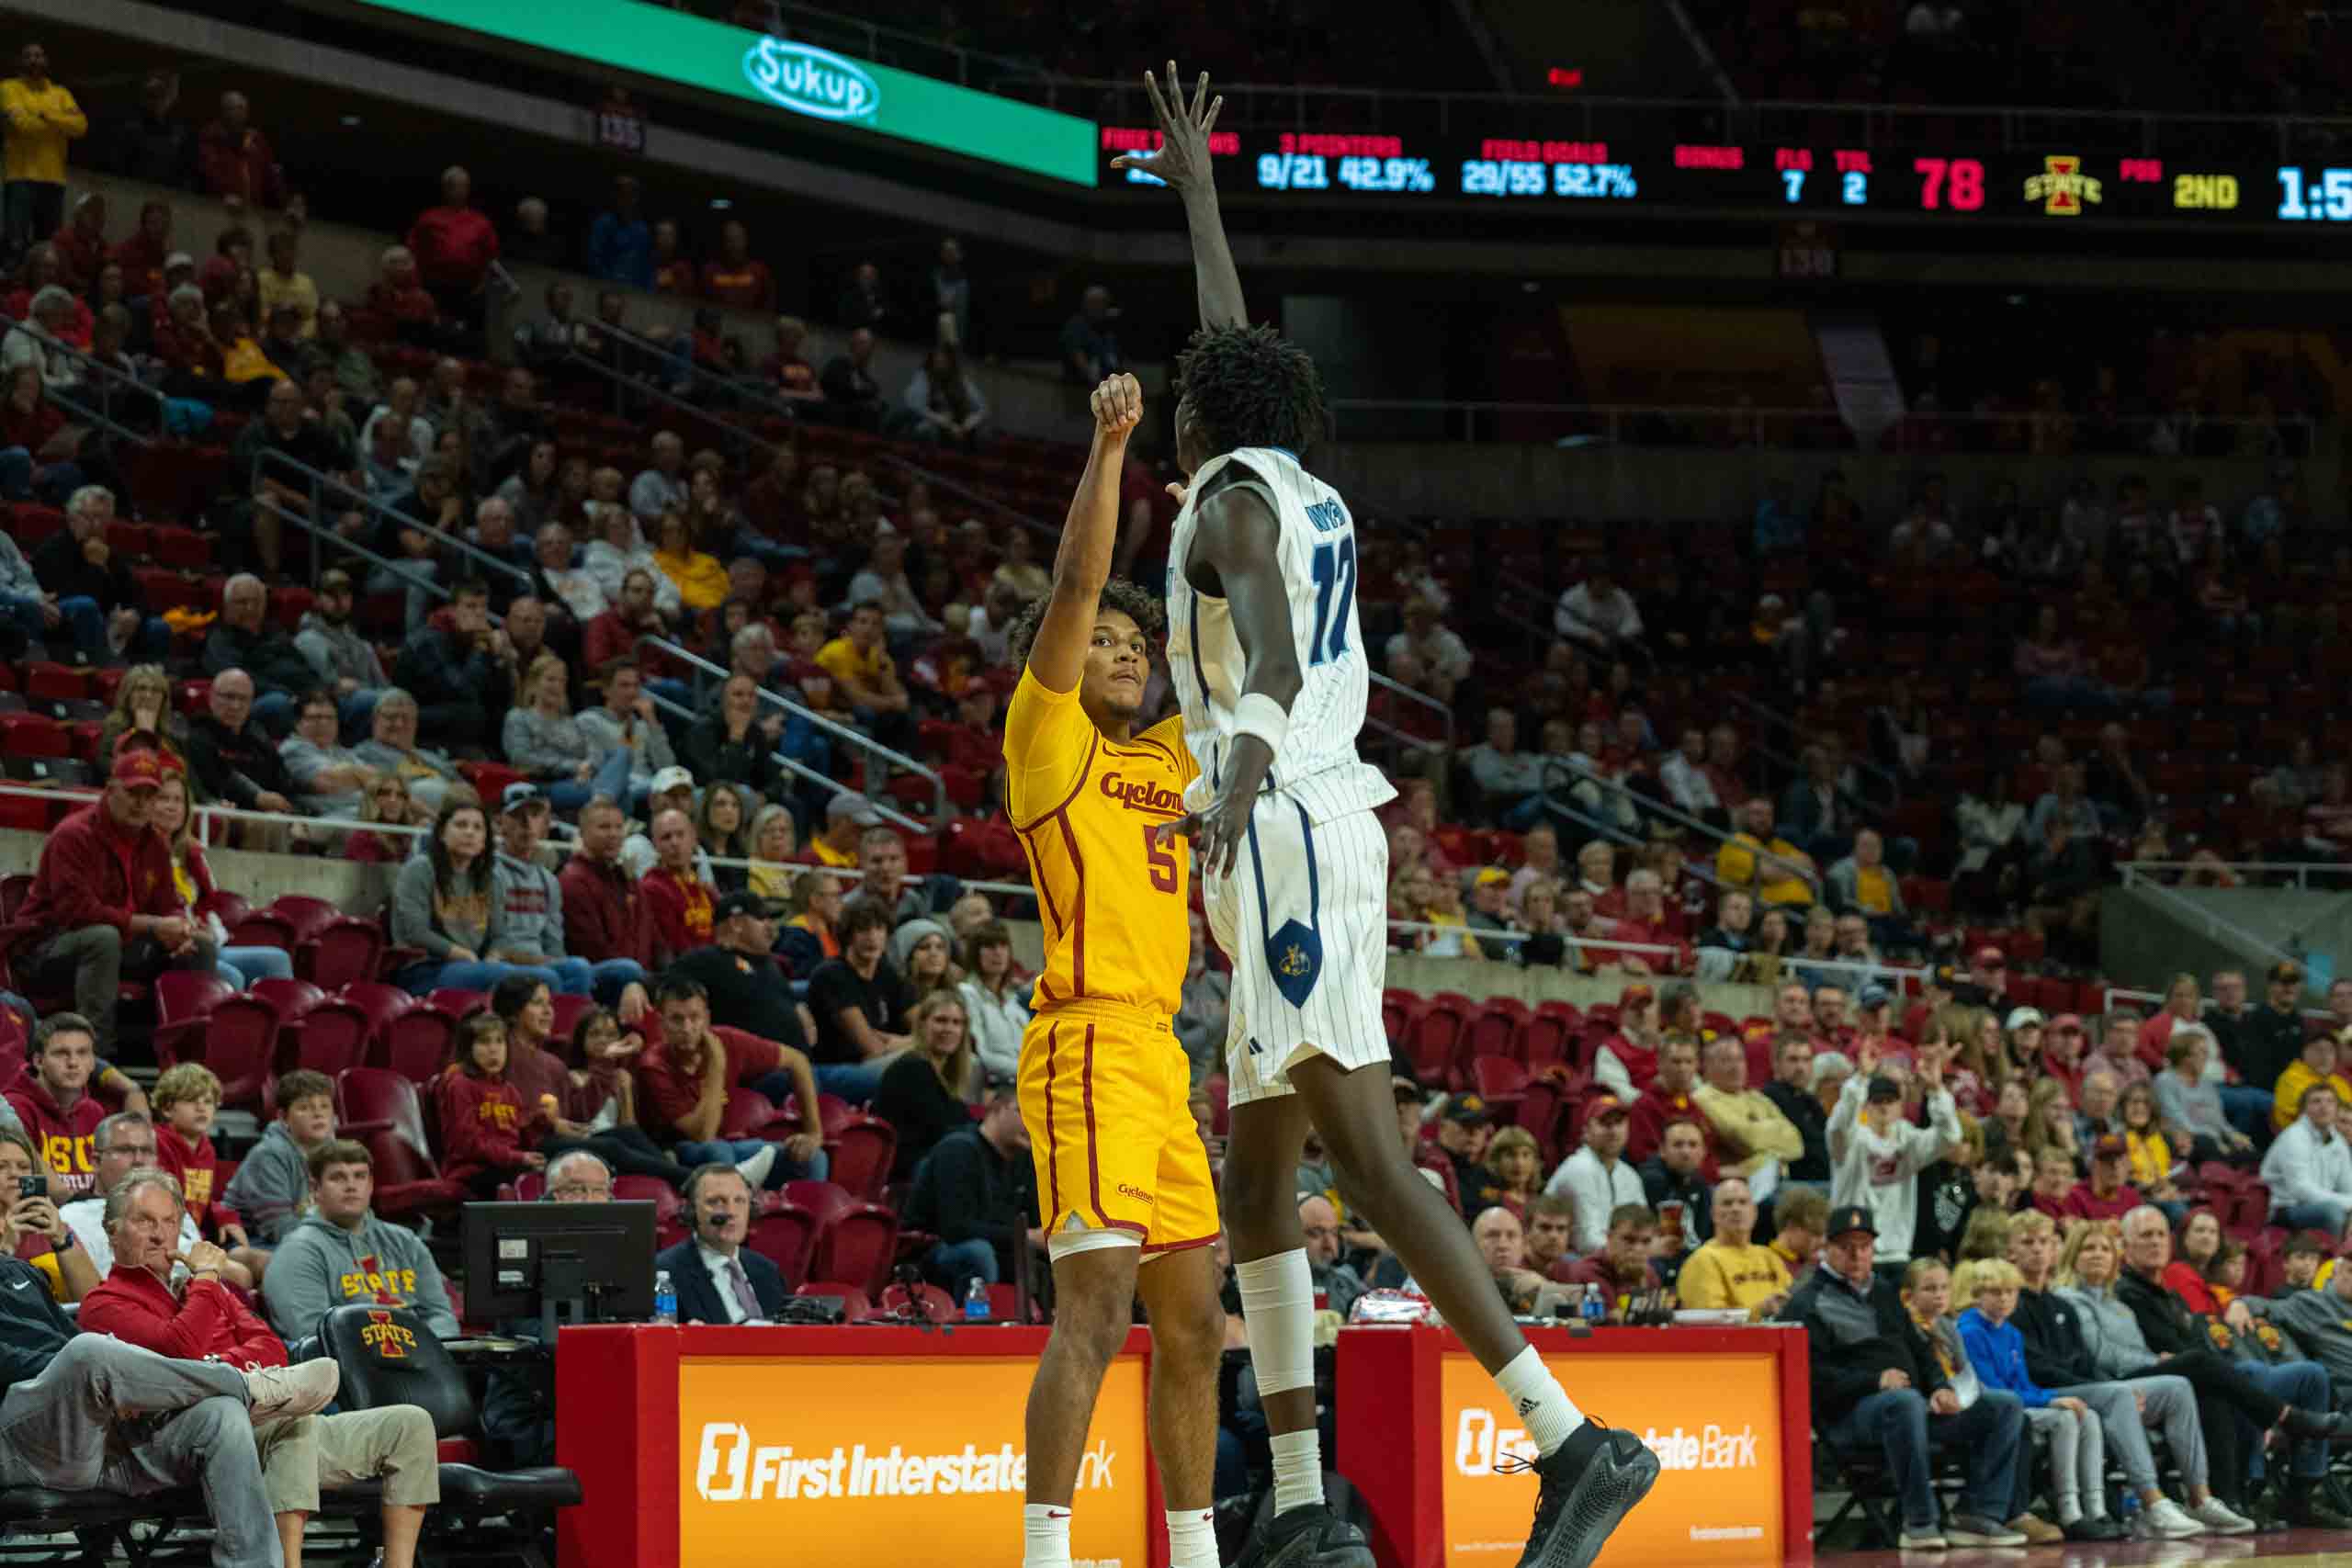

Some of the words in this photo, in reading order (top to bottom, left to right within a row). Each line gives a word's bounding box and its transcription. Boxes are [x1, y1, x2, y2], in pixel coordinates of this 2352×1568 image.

[755, 36, 865, 117] Sukup
[1258, 152, 1329, 189] 9/21
[1339, 155, 1434, 191] 42.9%
[1462, 160, 1546, 197] 29/55
[1554, 163, 1637, 197] 52.7%
[1782, 169, 1805, 203] 7
[1842, 170, 1867, 204] 2
[1914, 158, 1984, 209] 78
[2175, 174, 2238, 209] 2ND
[1100, 772, 1184, 812] Cyclon
[1143, 824, 1179, 896] 5
[341, 1269, 416, 1299] STATE
[361, 1323, 417, 1348] STATE
[1702, 1424, 1758, 1470] Bank
[750, 1446, 846, 1500] First
[847, 1445, 1027, 1498] Interstate
